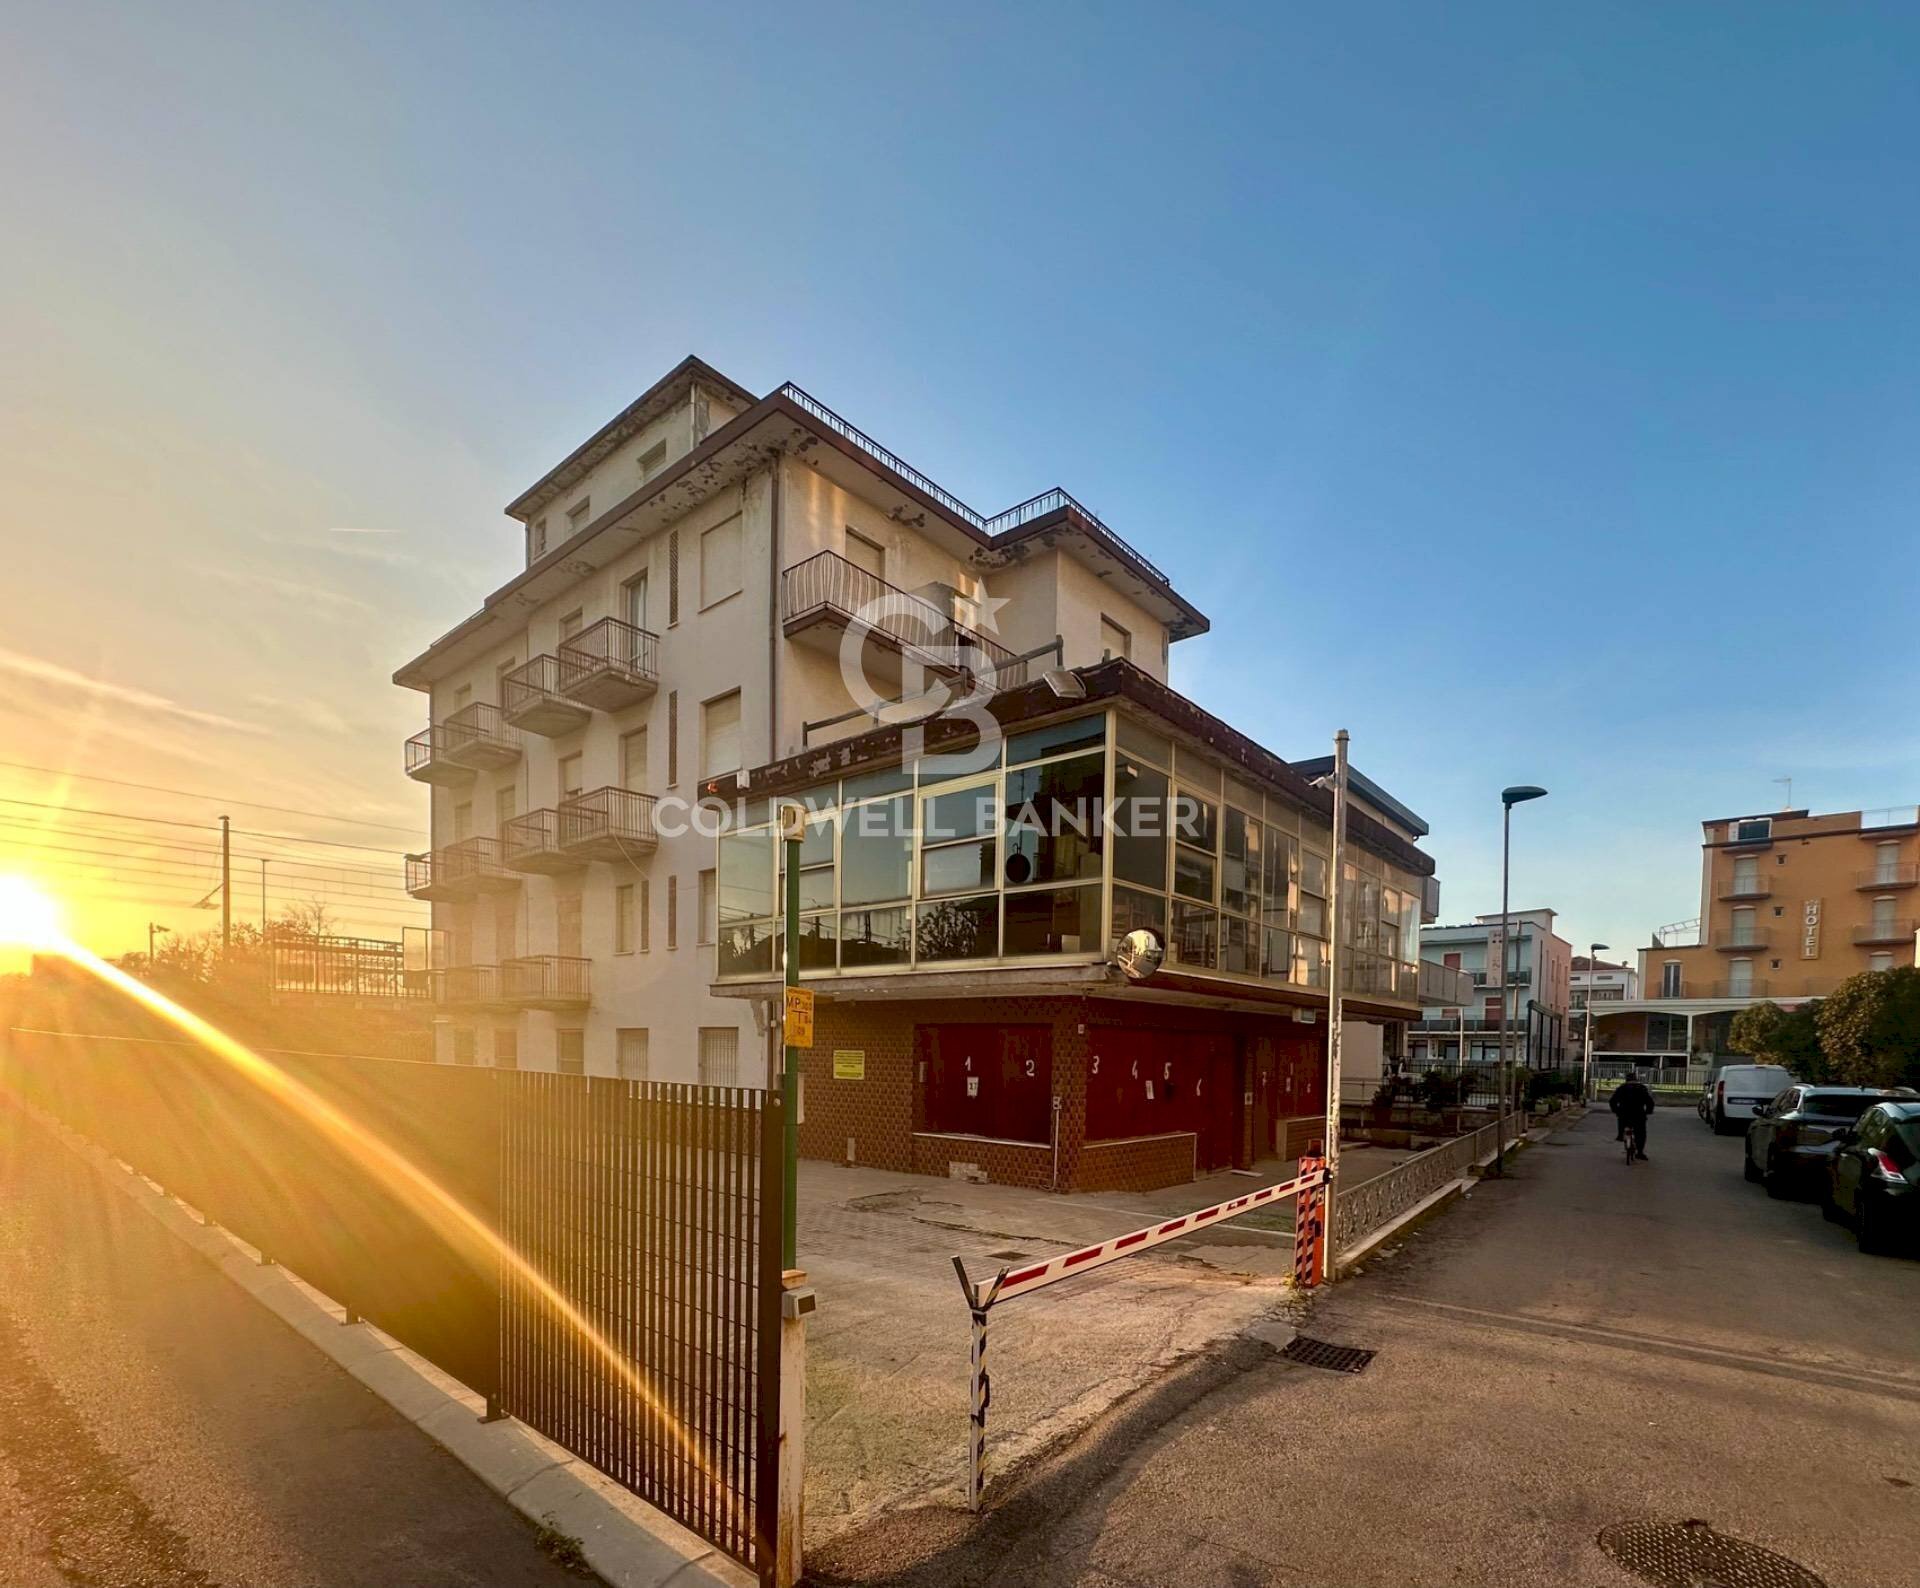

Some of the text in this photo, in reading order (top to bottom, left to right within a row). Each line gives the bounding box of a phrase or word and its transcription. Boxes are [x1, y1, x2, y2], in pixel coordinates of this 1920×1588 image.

[1805, 904, 1818, 957] HOTEL
[964, 1055, 971, 1072] 1
[1025, 1059, 1035, 1077] 2
[1091, 1055, 1100, 1074] 3
[1131, 1059, 1139, 1080] 4
[1163, 1061, 1172, 1080] 5
